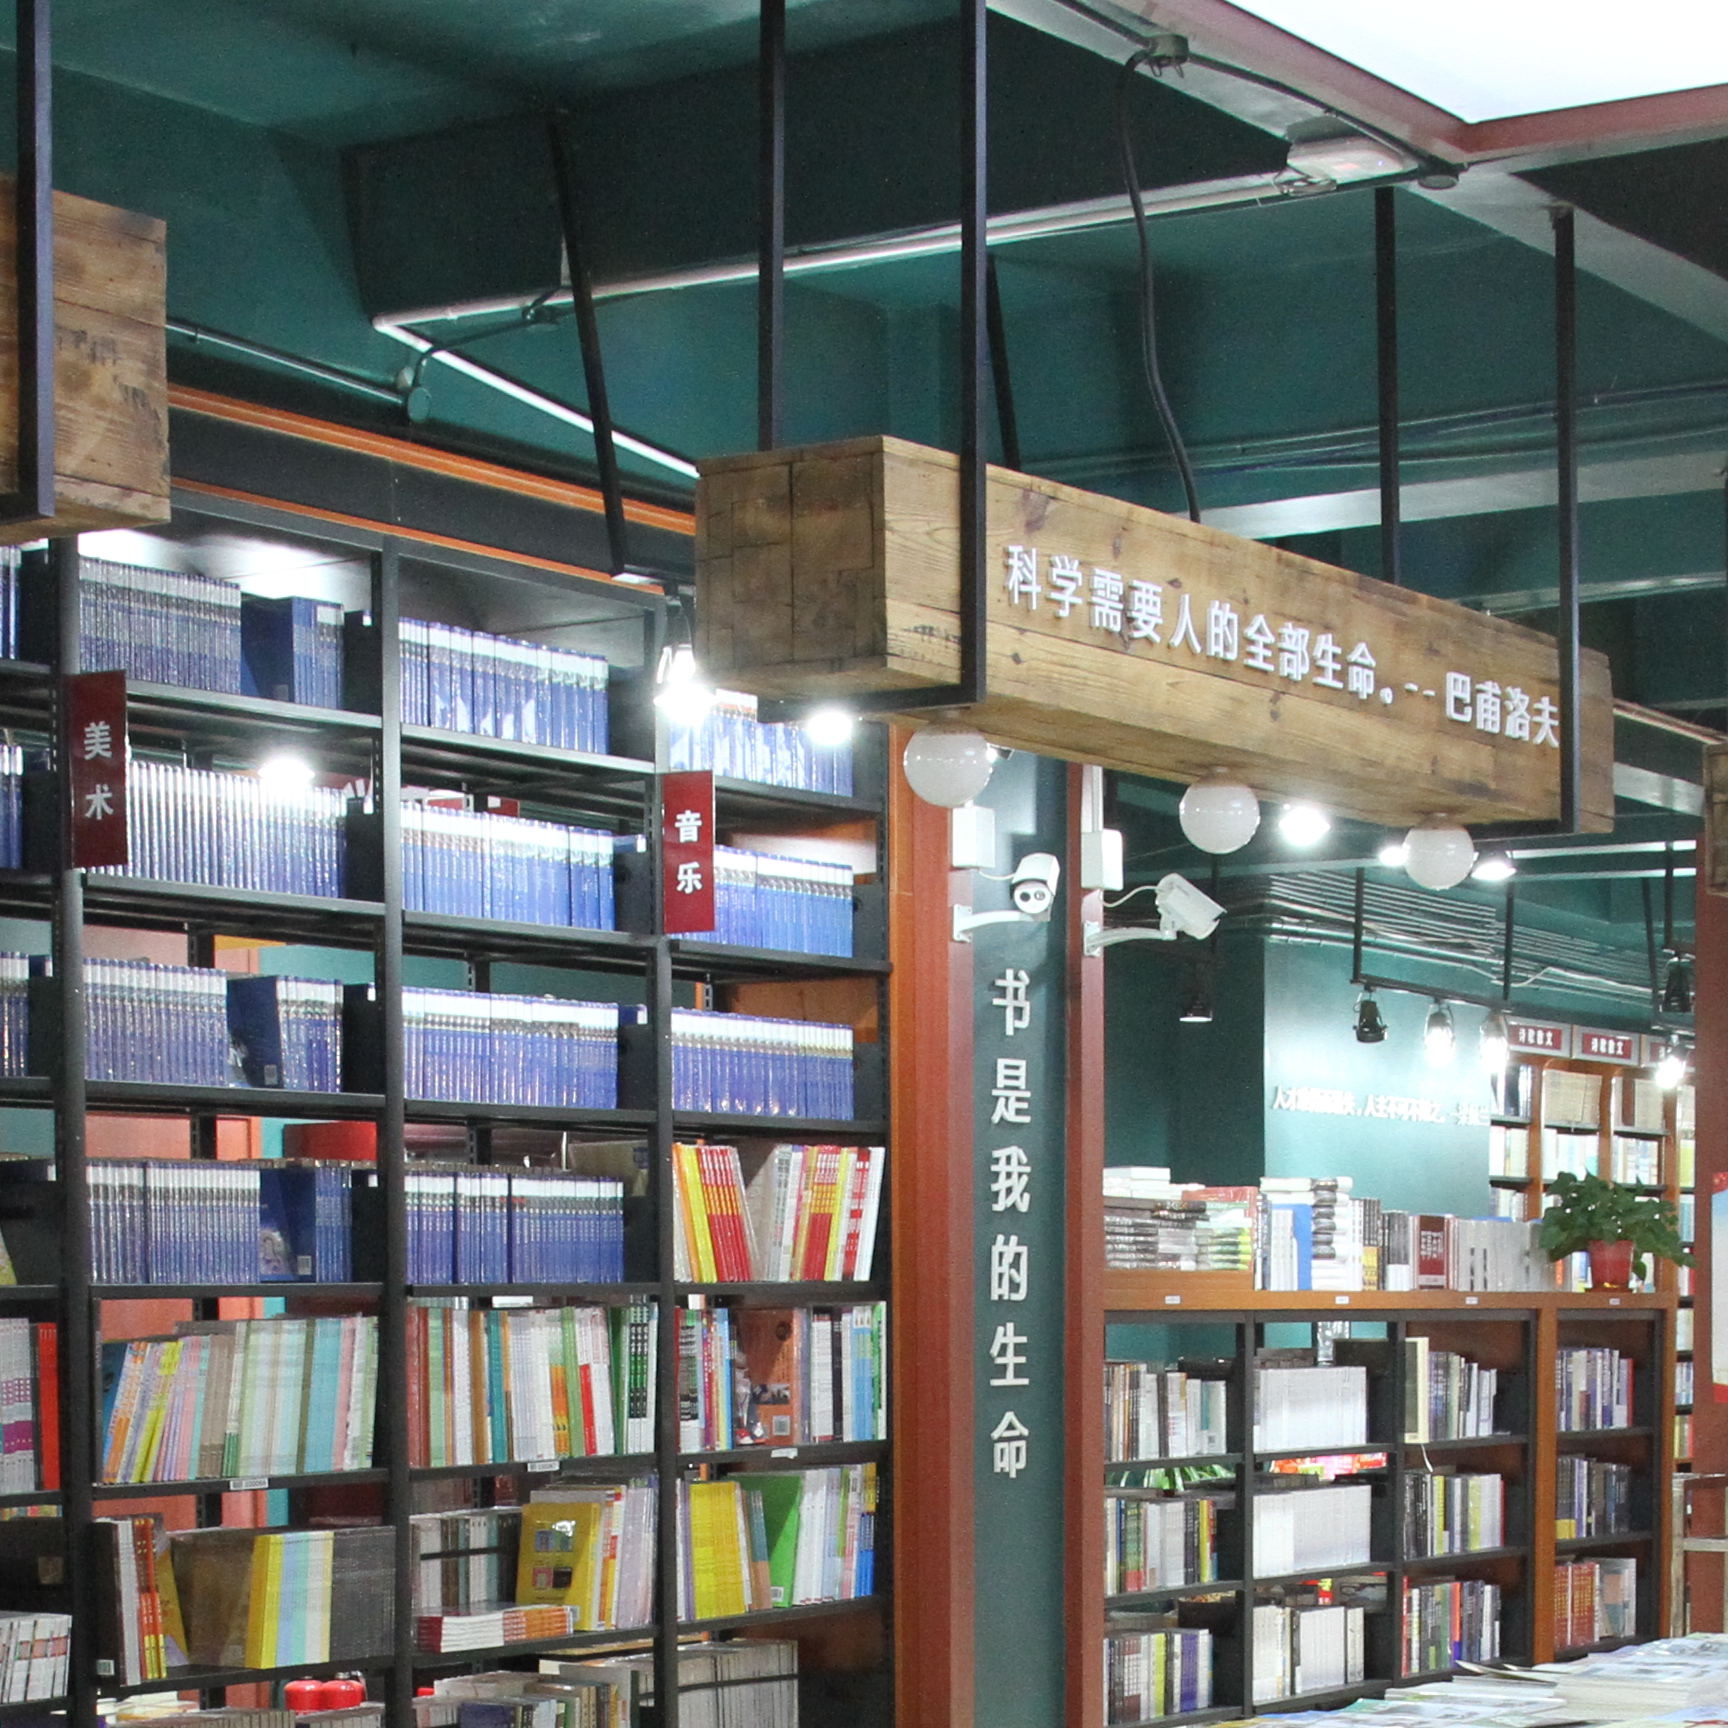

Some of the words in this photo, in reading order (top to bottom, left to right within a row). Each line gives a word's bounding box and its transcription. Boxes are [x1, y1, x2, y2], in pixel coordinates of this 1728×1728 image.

[83, 719, 116, 822] 美术
[674, 808, 704, 896] 音乐
[989, 968, 1032, 1480] 书是我的生命
